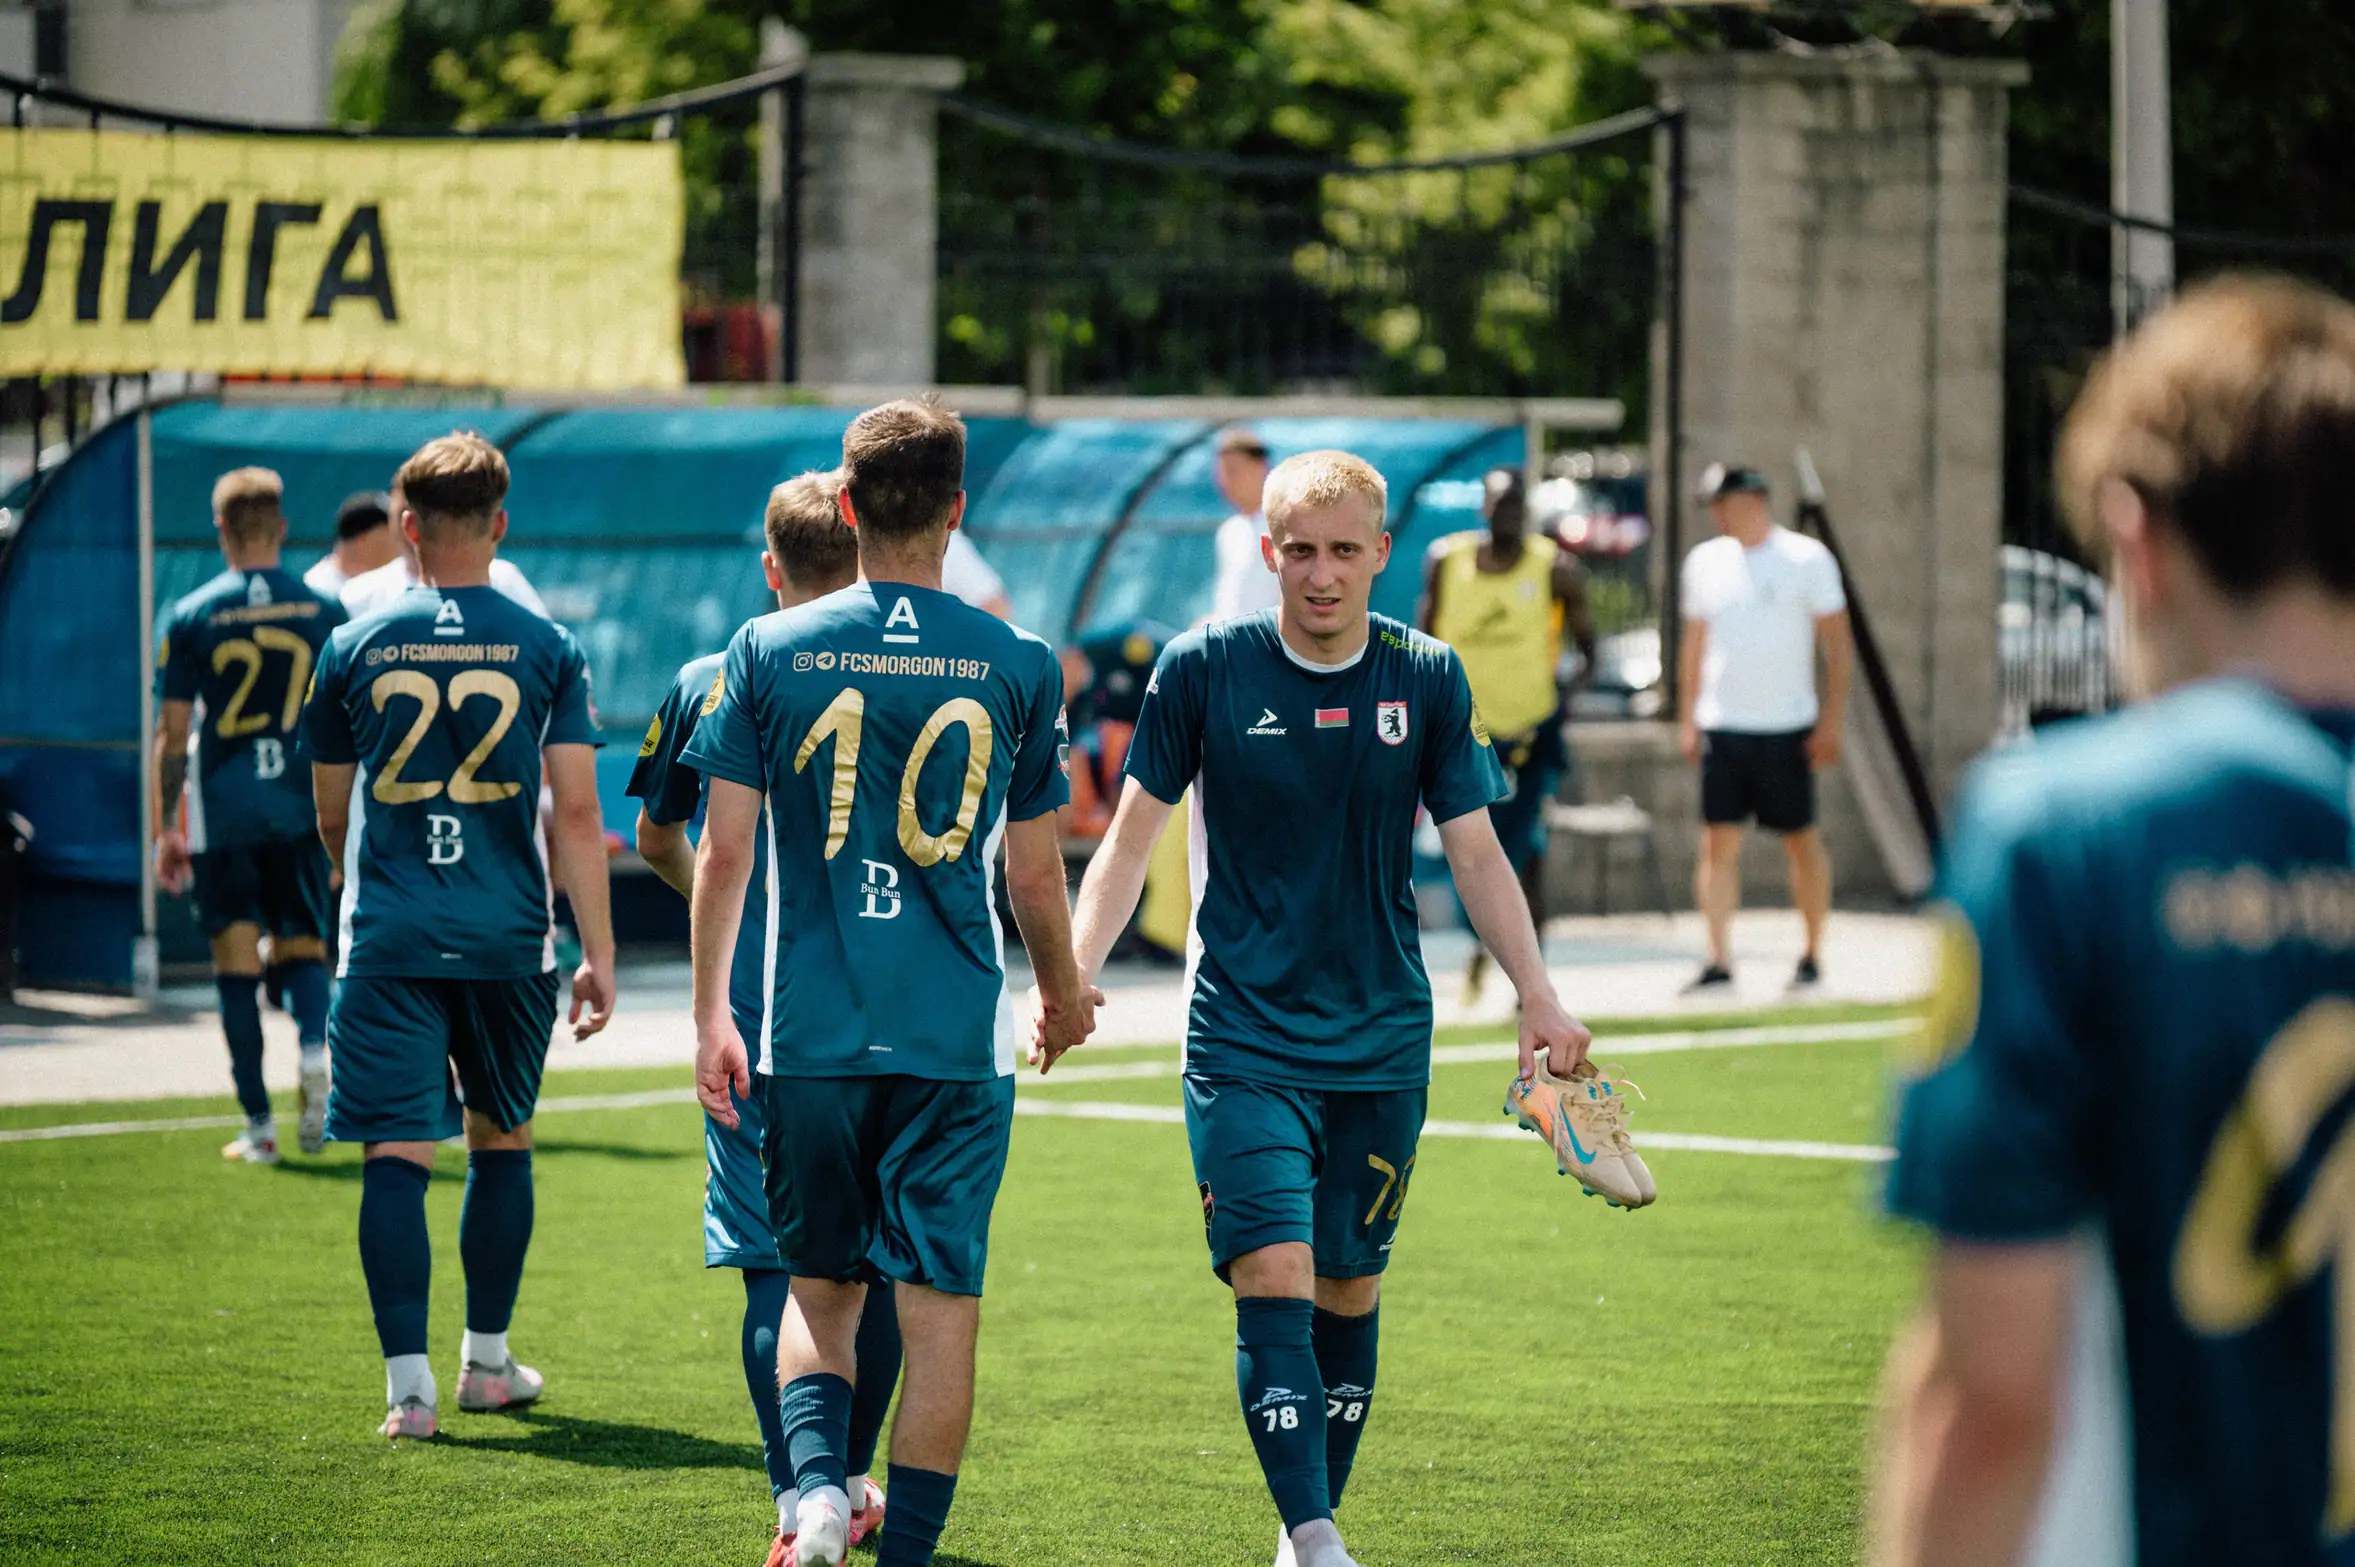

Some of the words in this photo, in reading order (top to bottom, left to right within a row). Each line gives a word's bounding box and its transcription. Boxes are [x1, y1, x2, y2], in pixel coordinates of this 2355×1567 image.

[0, 199, 399, 322] ЛИГА
[212, 625, 311, 738] 27
[371, 669, 521, 804] 22
[1247, 727, 1287, 735] DEMIX
[794, 687, 993, 867] 10
[861, 883, 879, 895] Bun
[881, 887, 901, 899] Bun
[1262, 1405, 1299, 1432] 78
[1326, 1398, 1364, 1422] 78
